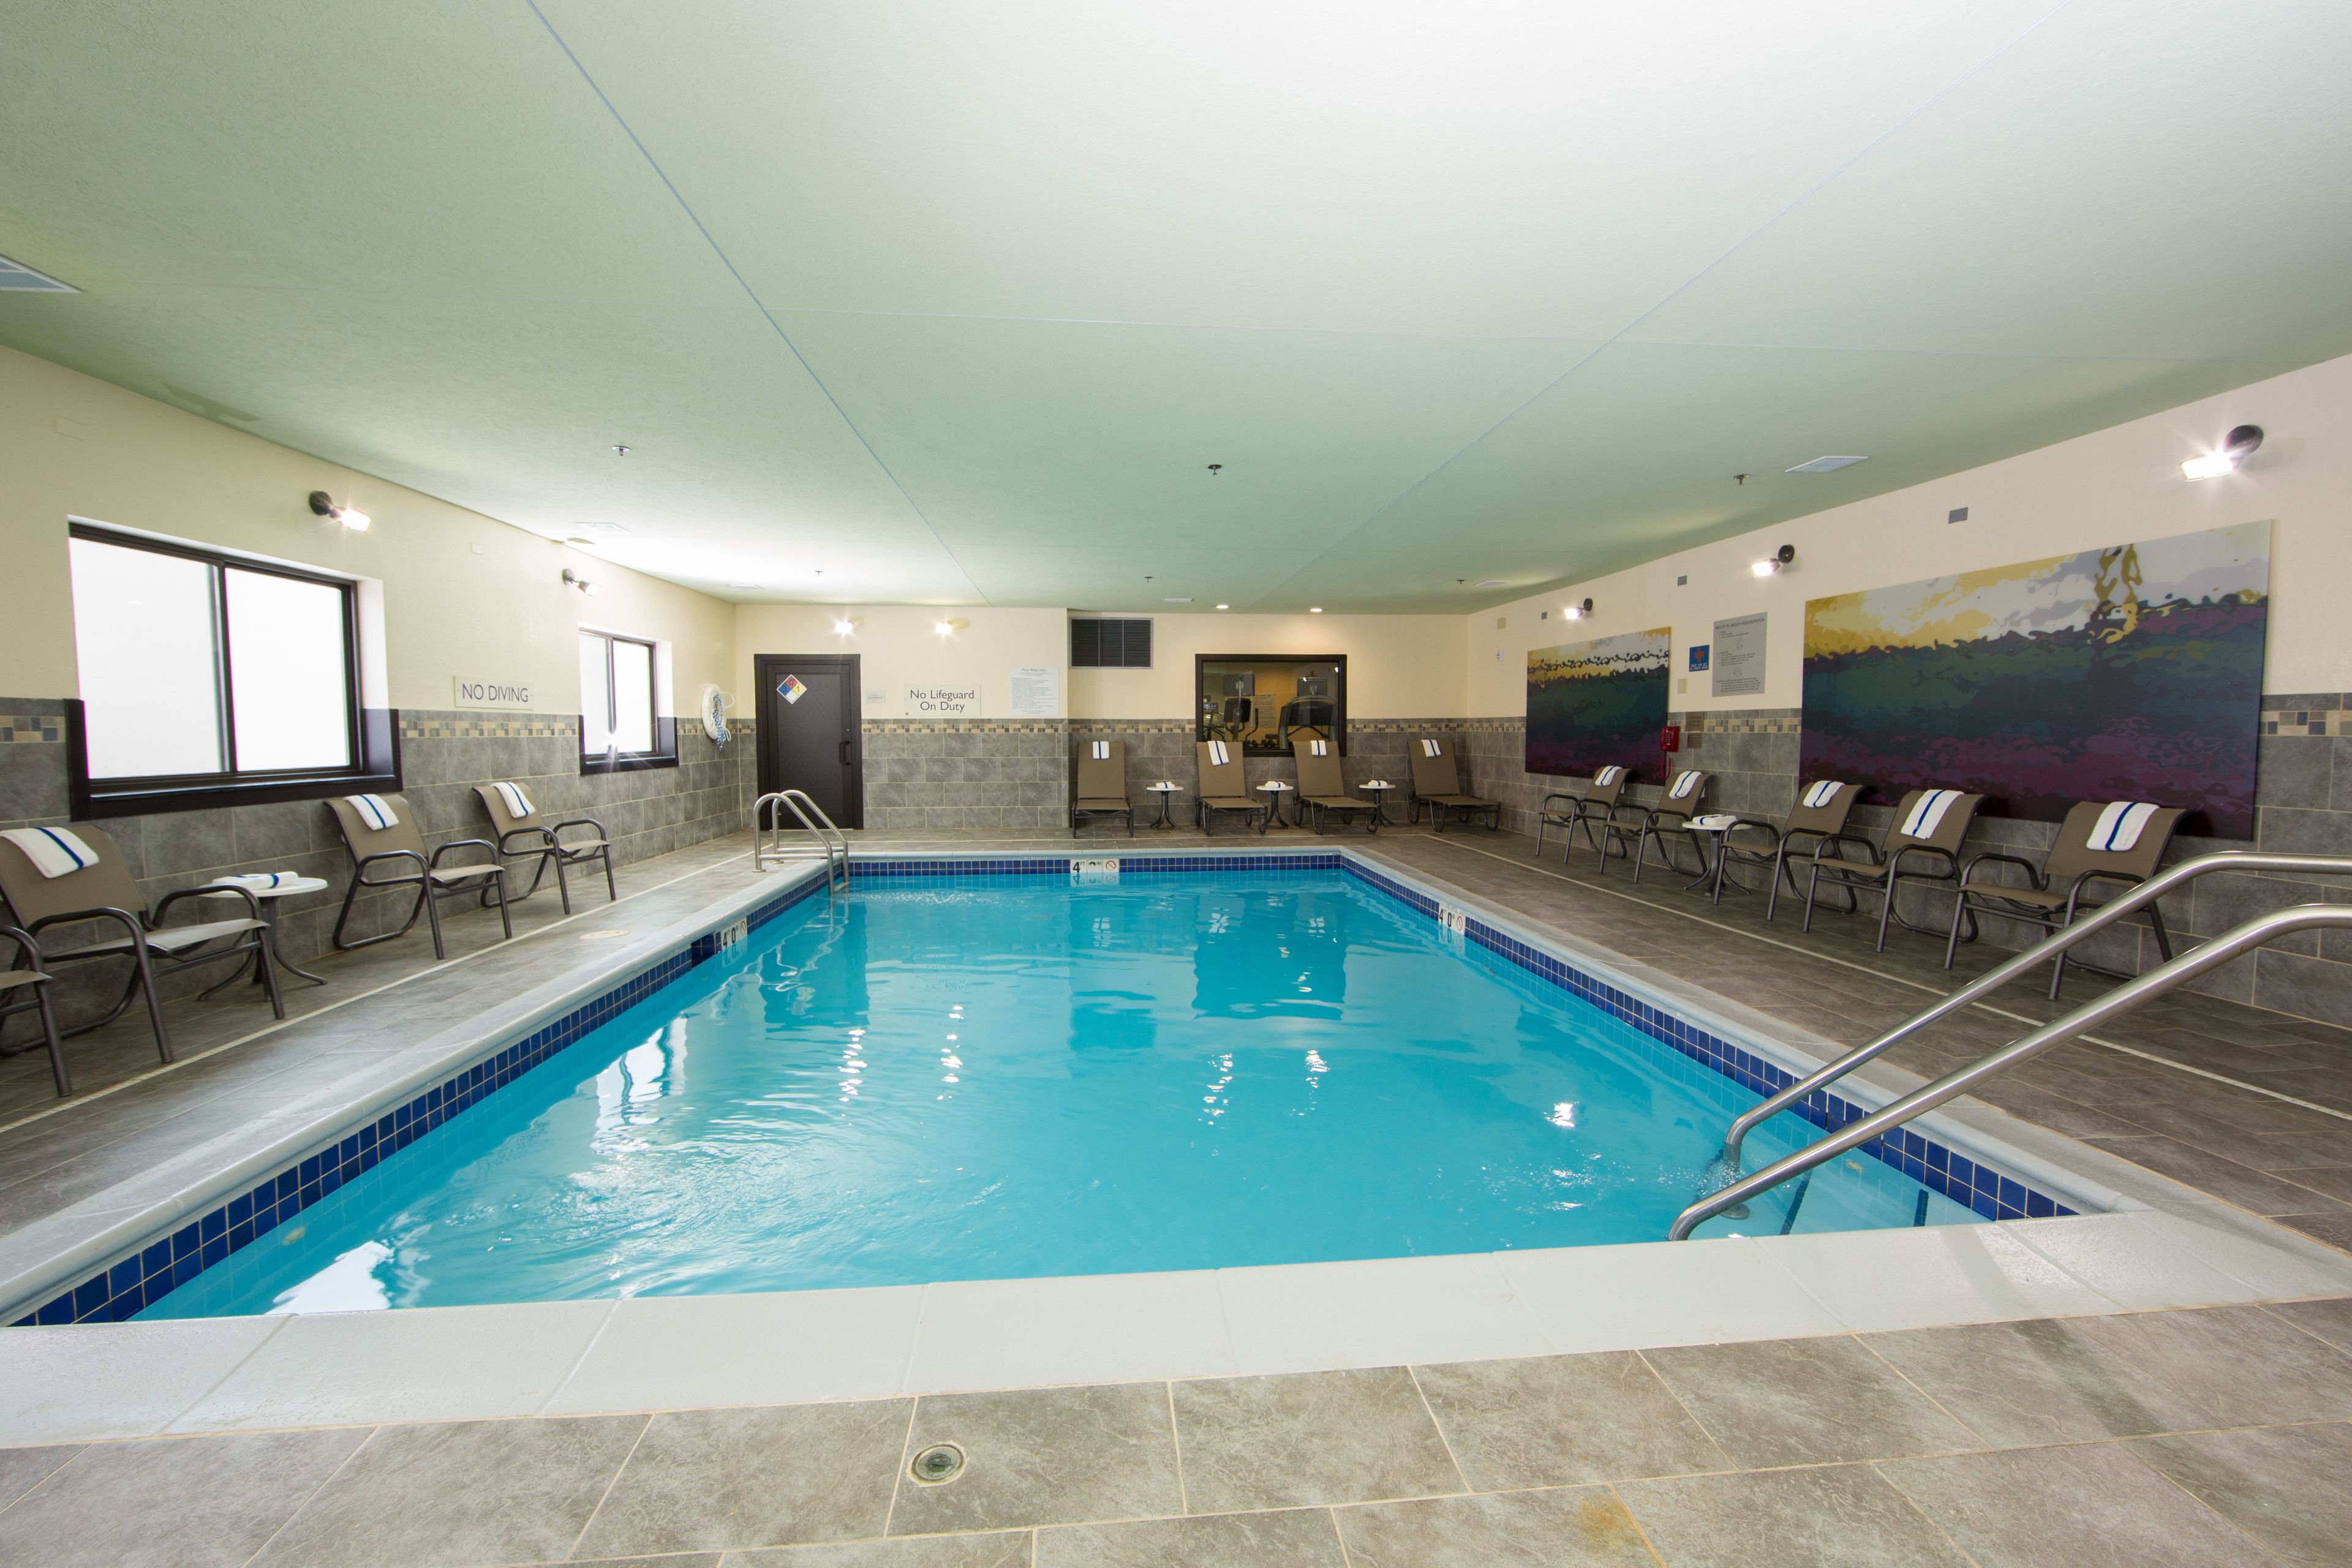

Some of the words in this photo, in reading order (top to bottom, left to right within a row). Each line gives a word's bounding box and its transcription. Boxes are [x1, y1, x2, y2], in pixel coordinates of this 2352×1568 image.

[462, 683, 484, 700] NO
[488, 685, 529, 703] DIVING
[910, 690, 926, 699] No
[930, 690, 974, 701] Lifeguard
[920, 701, 936, 710] On
[940, 701, 965, 713] Duty
[1072, 861, 1080, 873] 4
[1439, 908, 1443, 923] 4
[1448, 912, 1452, 927] 0
[723, 932, 727, 948] 4
[732, 927, 736, 943] 0
